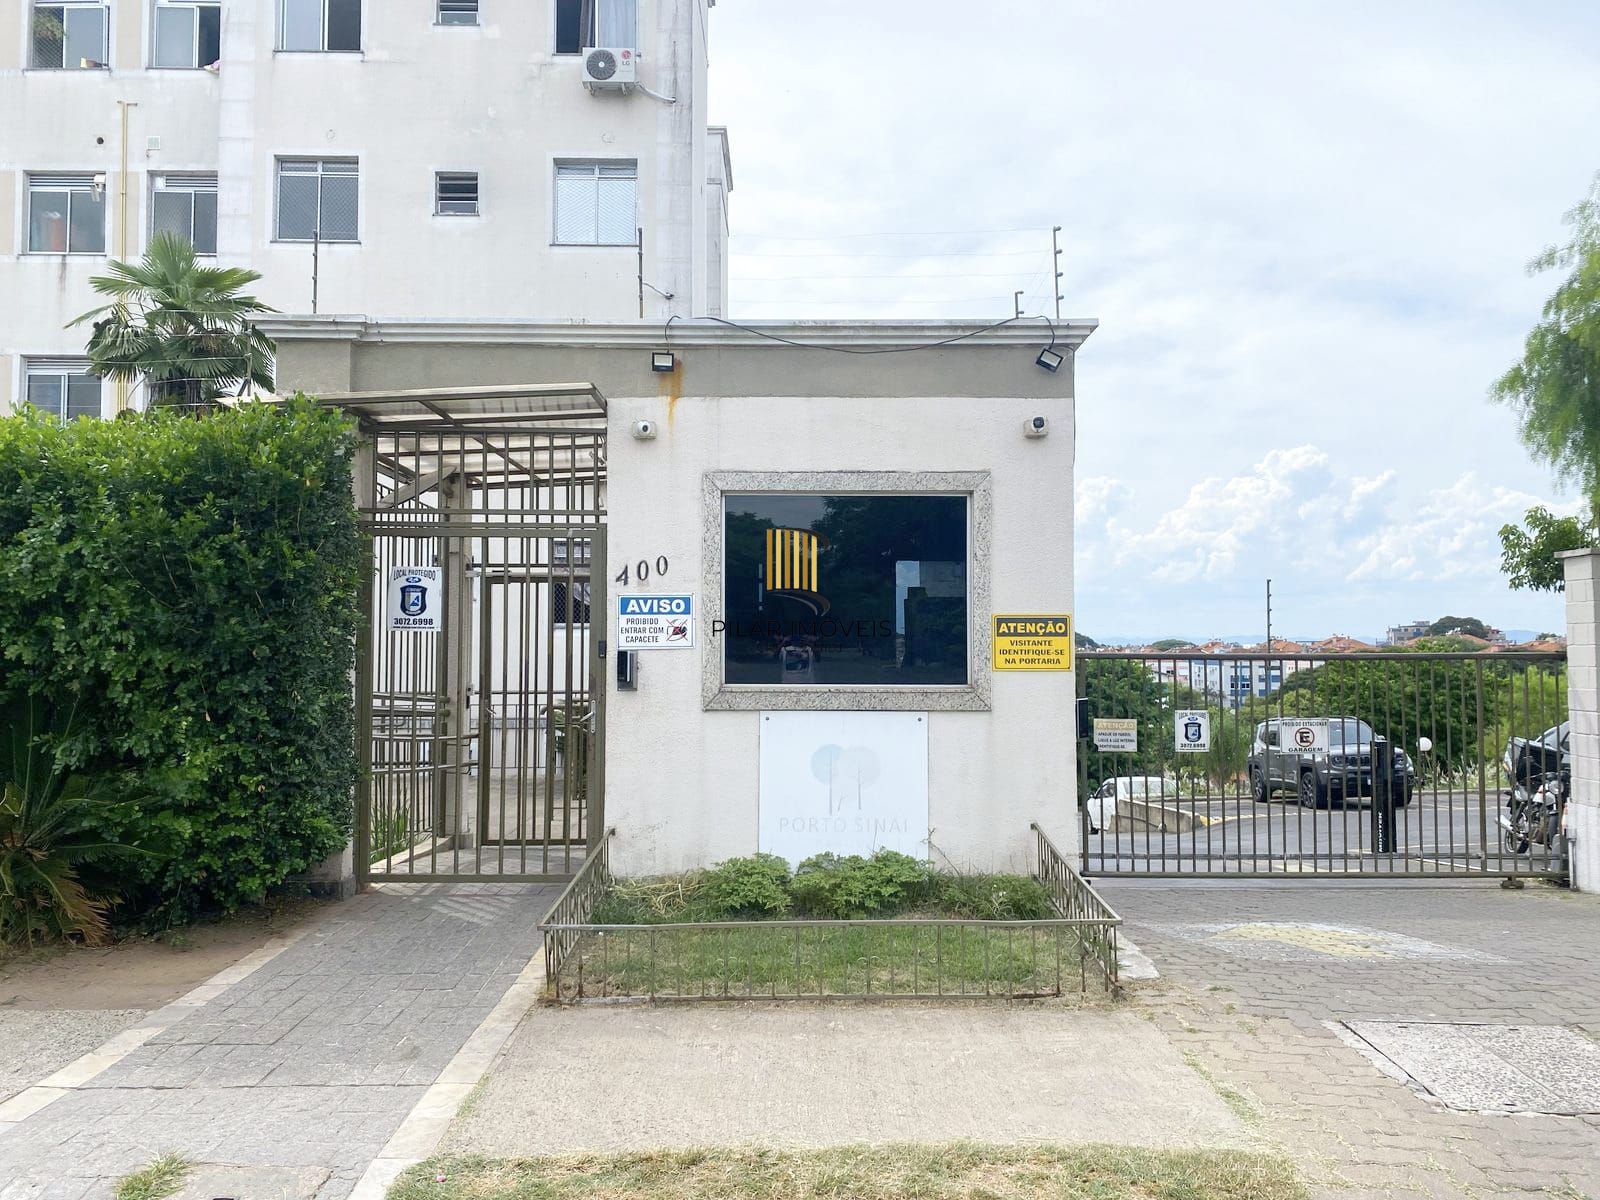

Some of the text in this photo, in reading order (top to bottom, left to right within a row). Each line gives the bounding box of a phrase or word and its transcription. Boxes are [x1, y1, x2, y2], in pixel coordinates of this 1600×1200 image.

[393, 569, 436, 581] LOCAL PROTEGIDO
[615, 555, 668, 586] 400
[626, 599, 686, 613] AVISO
[393, 617, 434, 626] 3072.6998
[626, 617, 659, 625] PROIBIDO
[620, 626, 664, 634] ENTRAR COM
[998, 620, 1067, 636] ATENÇÃO
[625, 635, 659, 643] CAPACETE
[1010, 639, 1053, 647] VISITANTE
[999, 649, 1065, 657] IDENTIFIQUE-SE
[779, 817, 847, 833] PORTO
